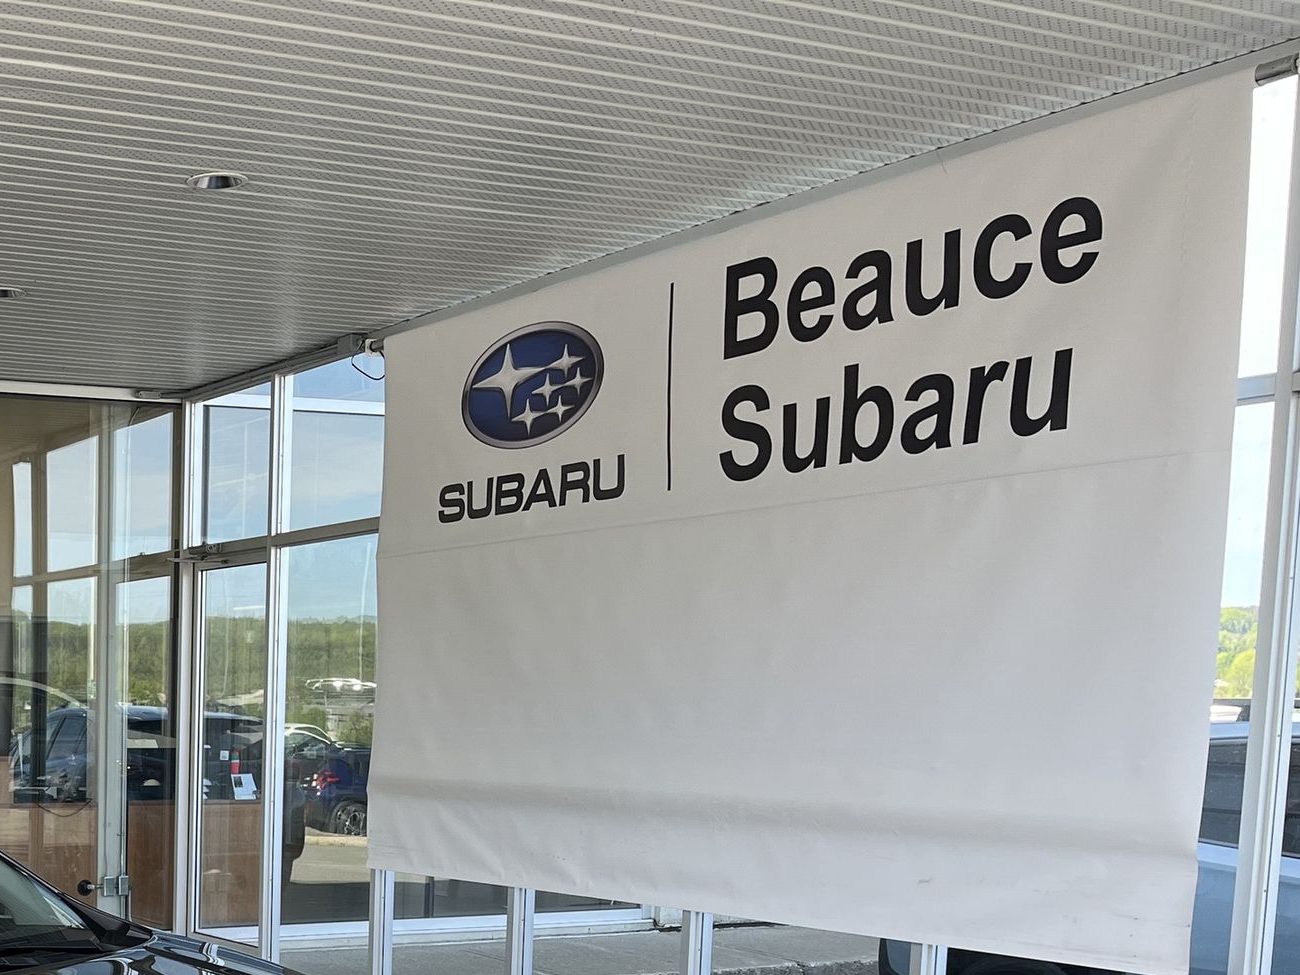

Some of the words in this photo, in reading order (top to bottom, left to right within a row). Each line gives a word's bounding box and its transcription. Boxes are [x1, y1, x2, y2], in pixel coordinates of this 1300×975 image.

[722, 195, 1104, 360] Beauce
[718, 346, 1074, 482] Subaru
[438, 454, 626, 524] SUBARU
